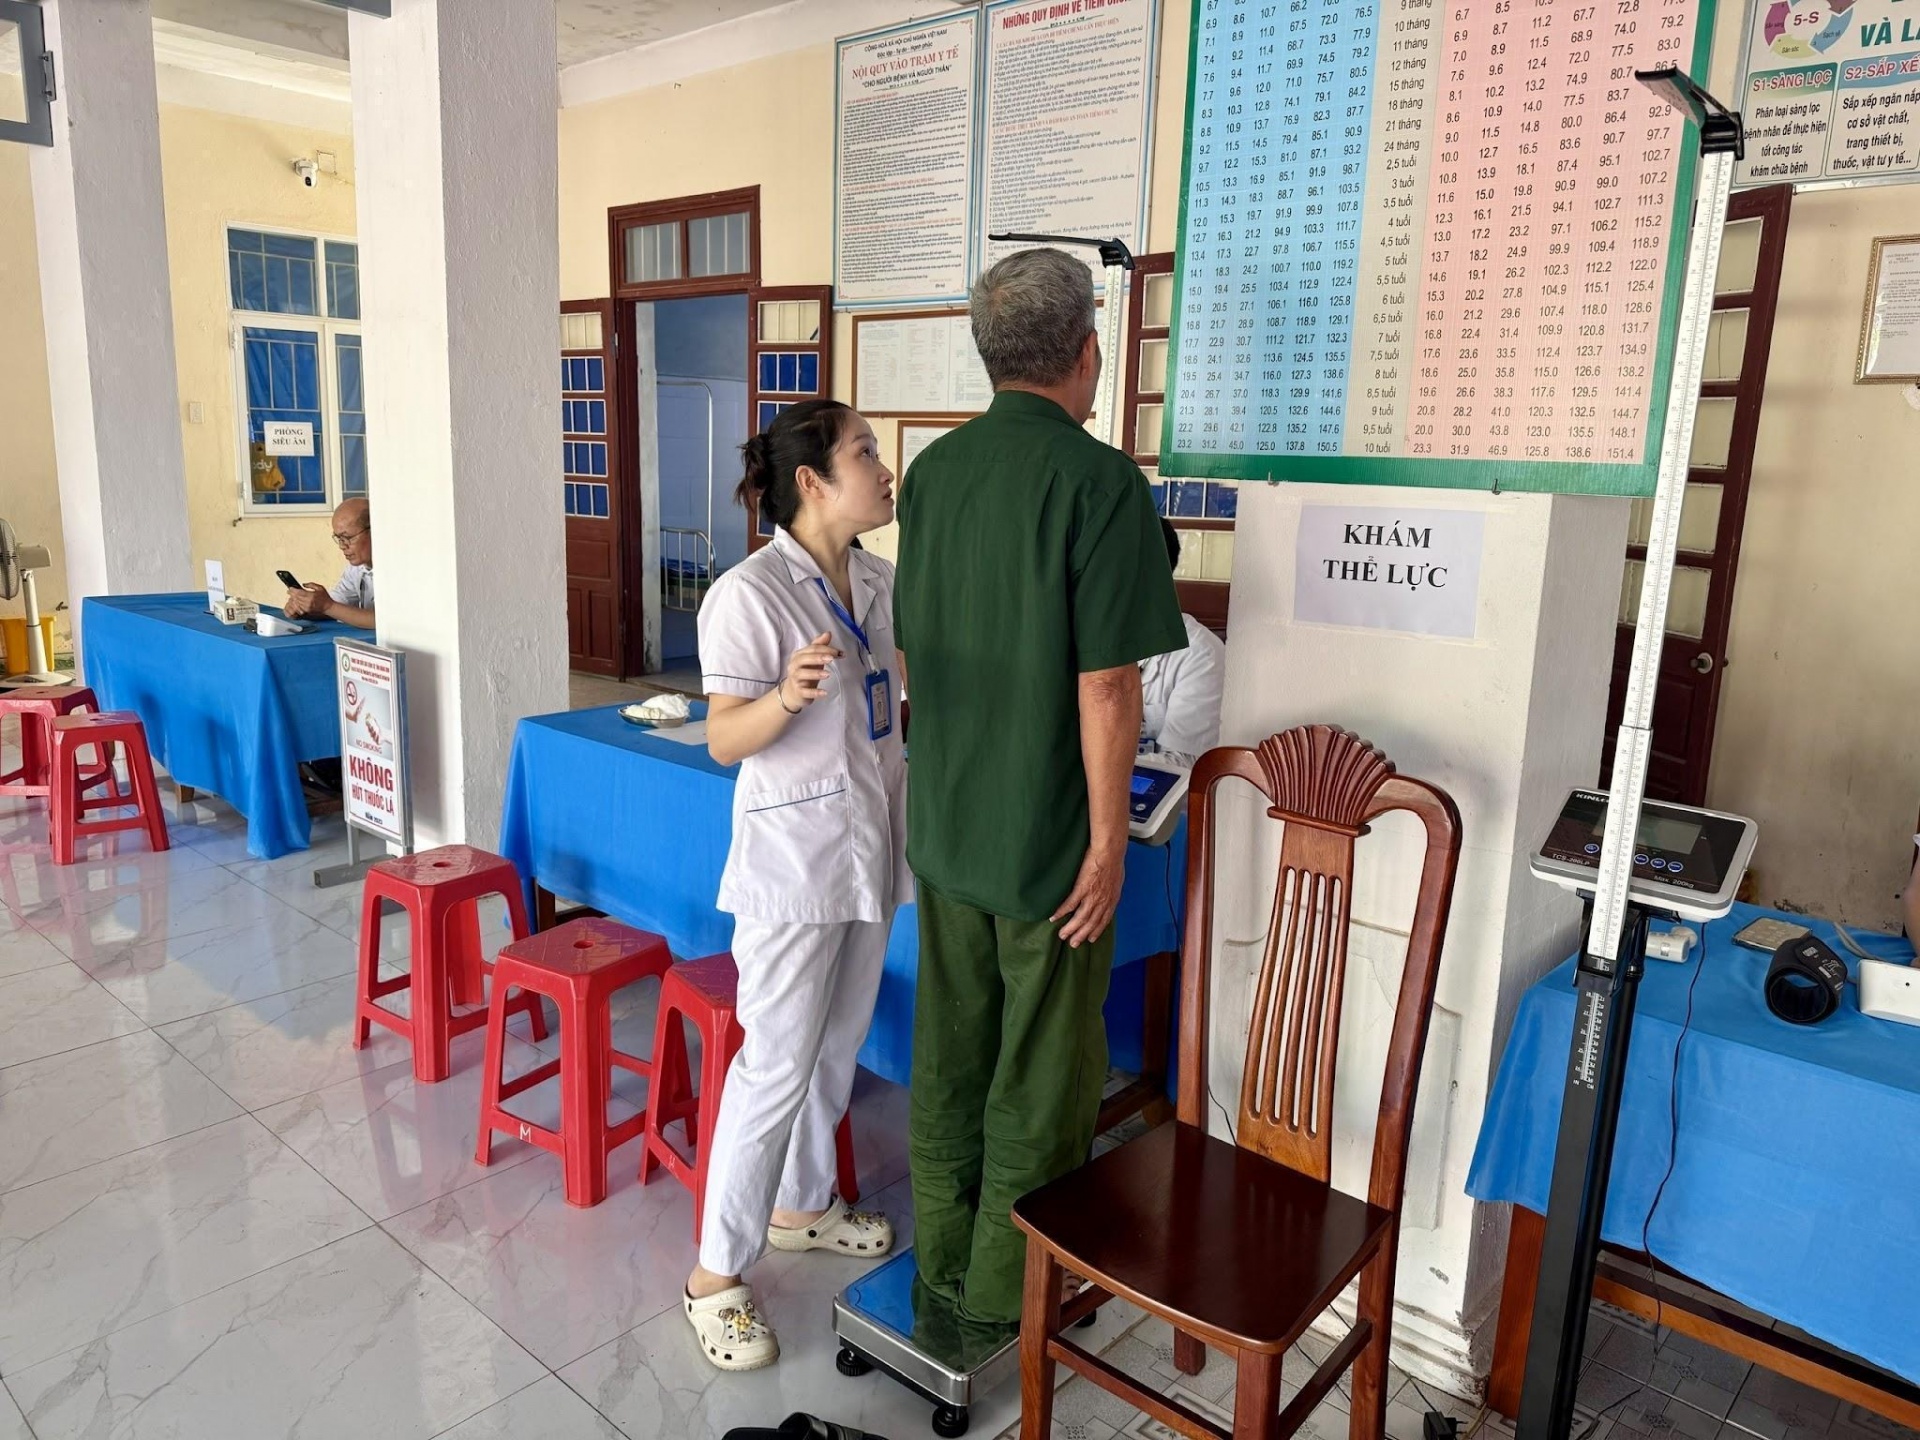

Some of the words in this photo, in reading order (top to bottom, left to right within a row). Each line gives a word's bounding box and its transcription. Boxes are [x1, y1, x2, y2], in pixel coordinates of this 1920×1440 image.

[1002, 11, 1030, 30] NHỮNG
[1032, 7, 1048, 24] QUY
[1049, 3, 1069, 21] ĐỊNH
[1793, 11, 1820, 27] 5-S
[1861, 17, 1891, 47] VÀ
[1901, 18, 1920, 42] L
[852, 64, 868, 80] NỘI
[869, 62, 888, 76] QUY
[889, 57, 908, 71] VÀO
[909, 52, 936, 67] TRẠM
[938, 51, 944, 61] Y
[946, 43, 960, 59] TẾ
[1202, 90, 1214, 102] 7.7
[1229, 85, 1242, 98] 9.6
[1255, 80, 1272, 94] 12.0
[1285, 75, 1303, 89] 71.0
[1316, 70, 1335, 85] 75.7
[1349, 65, 1368, 79] 80.5
[1390, 59, 1402, 72] 12
[1402, 56, 1427, 71] tháng
[1453, 49, 1467, 63] 7.0
[1490, 42, 1506, 56] 8.9
[1529, 35, 1550, 50] 11.5
[1570, 29, 1593, 44] 68.9
[1614, 20, 1637, 37] 74.0
[1661, 13, 1685, 30] 79.2
[1844, 56, 1896, 80] S2-SẮP
[1753, 72, 1803, 92] S1-SÀNG
[1806, 69, 1833, 89] LỌC
[1755, 107, 1774, 119] Phân
[1775, 105, 1789, 118] loại
[1789, 103, 1807, 117] sàng
[1809, 102, 1821, 115] lọc
[1843, 95, 1859, 111] Sắp
[1861, 93, 1877, 109] xếp
[1879, 92, 1902, 108] ngăn
[1743, 128, 1762, 141] bệnh
[1763, 125, 1781, 137] nhân
[1782, 120, 1793, 136] để
[1793, 122, 1809, 137] thực
[1810, 121, 1827, 134] hiện
[1847, 118, 1858, 129] cơ
[1860, 114, 1871, 128] sở
[1873, 114, 1886, 129] vật
[1888, 110, 1910, 125] chất,
[1761, 143, 1771, 157] tốt
[1772, 144, 1790, 157] công
[1791, 142, 1803, 154] tác
[1846, 137, 1869, 150] trang
[1871, 131, 1891, 147] thiết
[1893, 132, 1904, 146] bị,
[1750, 164, 1769, 177] khám
[1771, 163, 1788, 176] chữa
[1790, 161, 1808, 176] bệnh
[1833, 155, 1859, 170] thuốc,
[1862, 155, 1875, 169] vật
[1877, 154, 1887, 166] tư
[1887, 155, 1894, 168] y
[1192, 232, 1207, 243] 12.7
[1217, 230, 1233, 242] 16.3
[1244, 228, 1261, 240] 21.2
[1274, 225, 1291, 238] 94.9
[1303, 222, 1325, 235] 103.3
[1336, 219, 1357, 232] 111.7
[1387, 217, 1394, 228] 4
[1395, 213, 1412, 228] tuổi
[1435, 211, 1454, 225] 12.3
[1473, 207, 1492, 221] 16.1
[1510, 203, 1532, 217] 21.5
[1552, 199, 1573, 214] 94.1
[1594, 196, 1622, 211] 102.7
[1637, 192, 1664, 207] 111.3
[1184, 337, 1200, 349] 17.7
[1208, 336, 1225, 348] 22.9
[1235, 335, 1252, 347] 30.7
[1265, 333, 1285, 345] 111.2
[1294, 333, 1316, 345] 121.7
[1326, 332, 1348, 343] 132.3
[1378, 332, 1385, 344] 7
[1385, 329, 1401, 343] tuổi
[1424, 328, 1443, 340] 16.8
[1460, 327, 1481, 340] 22.4
[1499, 326, 1519, 339] 31.4
[1537, 323, 1563, 336] 109.9
[1578, 324, 1605, 337] 120.8
[1621, 321, 1650, 334] 131.7
[274, 427, 303, 436] PHÒNG
[1177, 438, 1193, 449] 23.2
[1201, 439, 1217, 449] 31.2
[1228, 440, 1245, 450] 45.0
[1256, 440, 1276, 451] 125.0
[1285, 440, 1305, 451] 137.8
[1316, 441, 1338, 452] 150.5
[1364, 442, 1375, 453] 10
[1375, 440, 1391, 453] tuổi
[1412, 442, 1432, 454] 23.3
[1450, 444, 1470, 456] 31.9
[1487, 444, 1508, 456] 46.9
[1524, 445, 1550, 457] 125.8
[1565, 446, 1592, 458] 138.6
[1607, 447, 1634, 459] 151.4
[1342, 520, 1433, 549] KHÁM
[1323, 555, 1378, 582] THỂ
[1387, 562, 1448, 591] LỰC
[349, 754, 394, 792] KHÔNG
[351, 782, 363, 802] HÚT
[364, 788, 385, 811] THUỐC
[385, 795, 395, 816] LÁ
[519, 1122, 532, 1144] M
